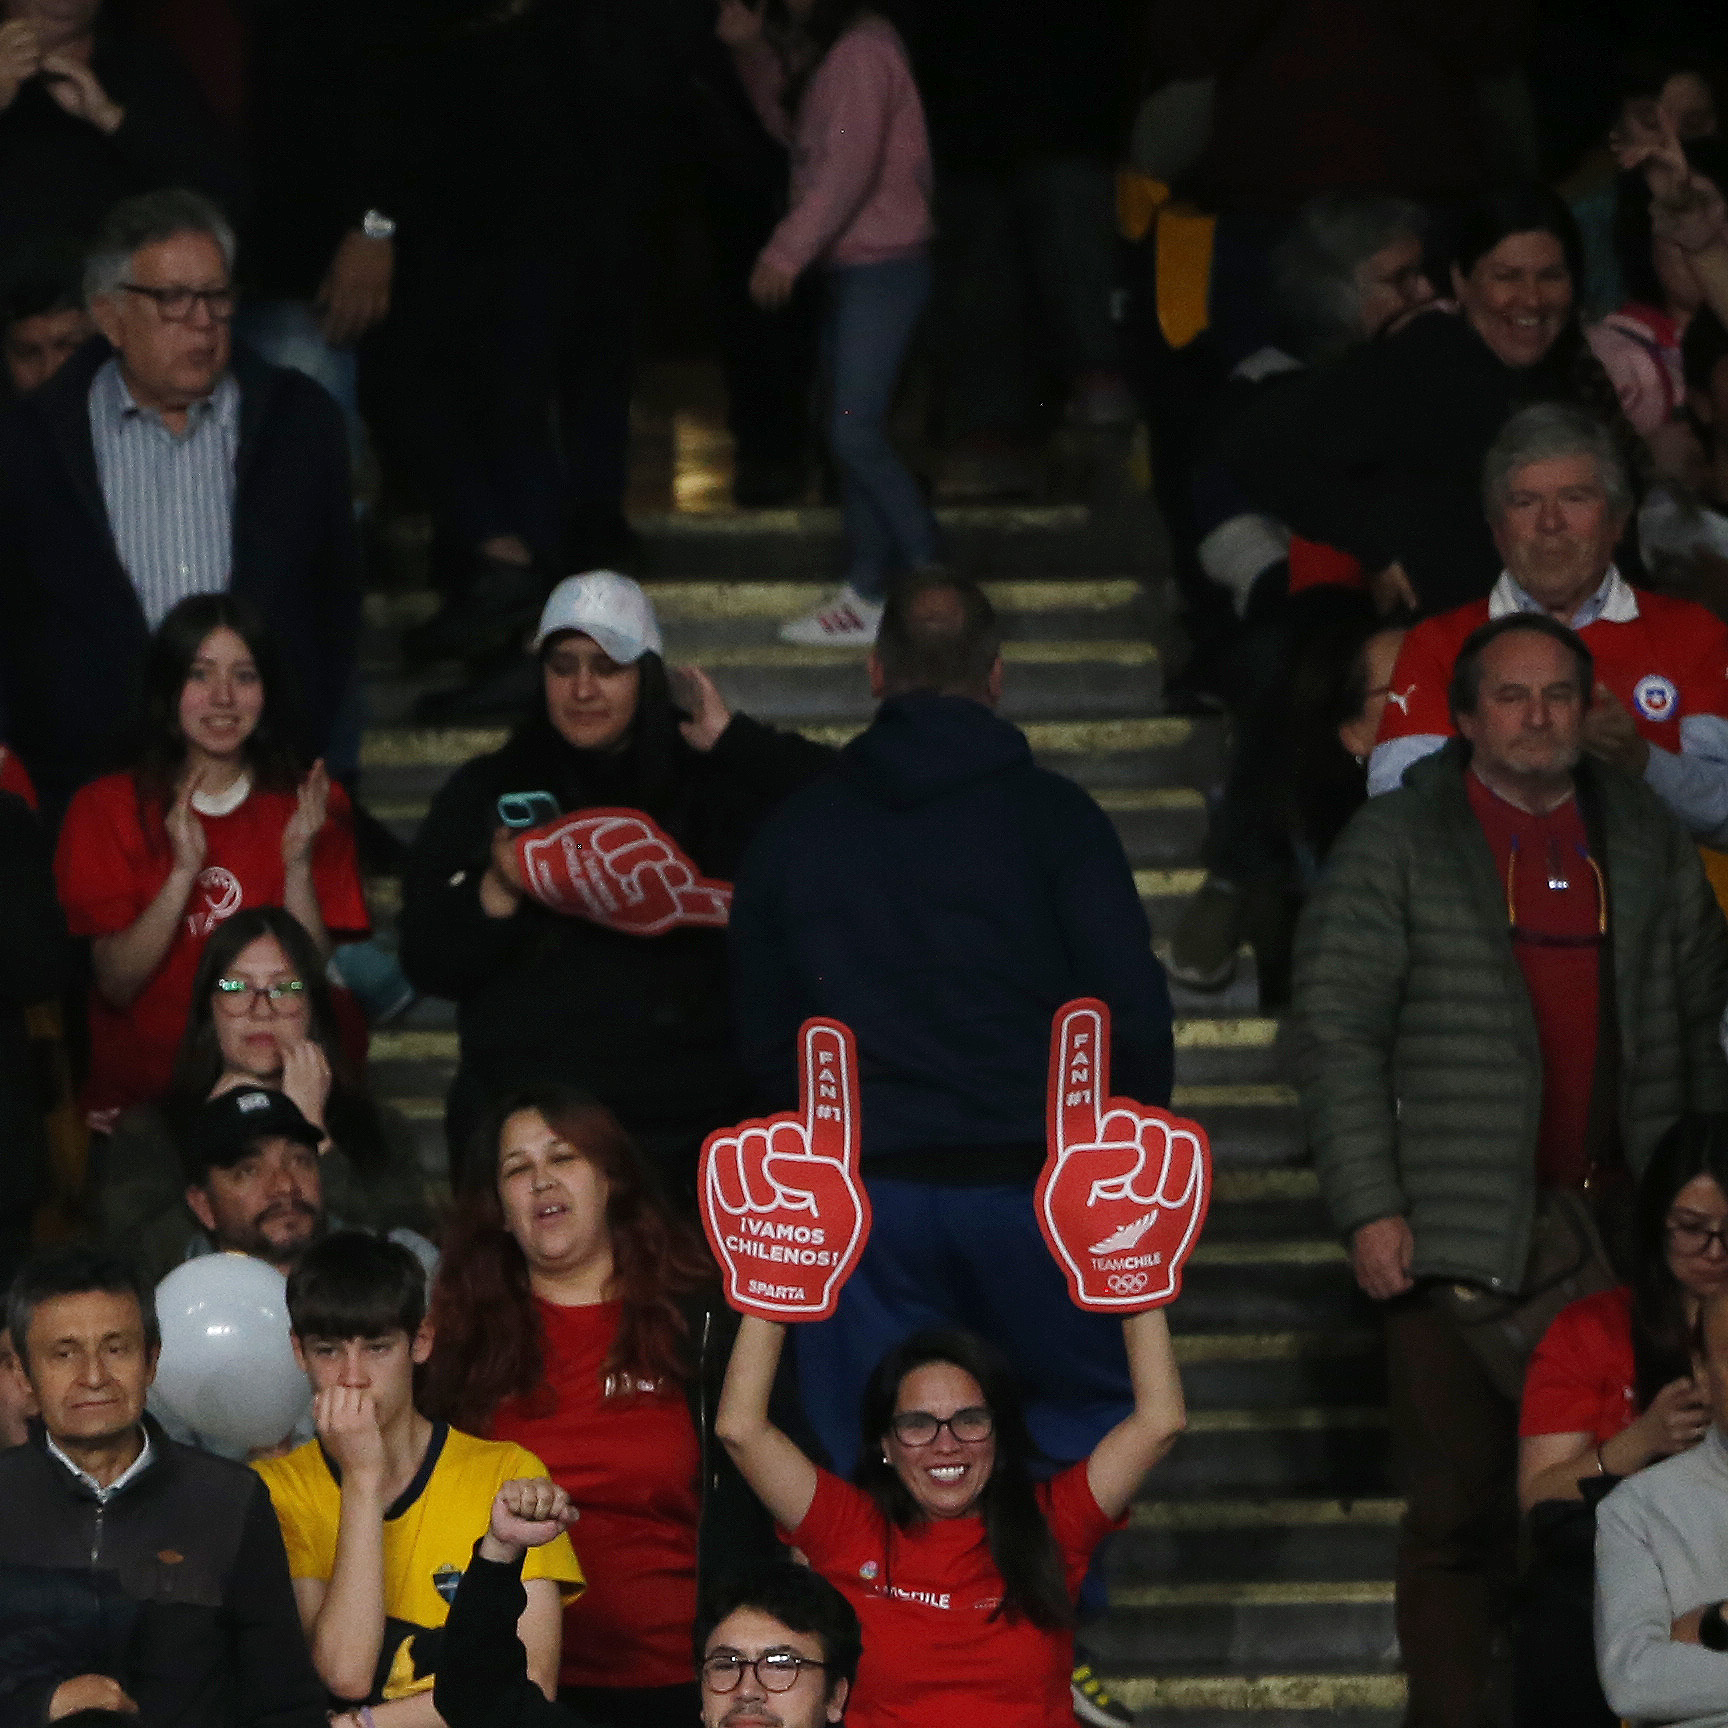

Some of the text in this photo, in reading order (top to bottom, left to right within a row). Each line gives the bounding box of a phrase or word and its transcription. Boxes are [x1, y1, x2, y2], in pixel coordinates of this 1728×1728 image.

[1070, 1033, 1089, 1084] FAN
[816, 1051, 841, 1123] FAN #1
[741, 1217, 826, 1246] ¡VAMOS
[725, 1235, 839, 1268] CHILENOS!
[747, 1278, 806, 1302] SPARTA
